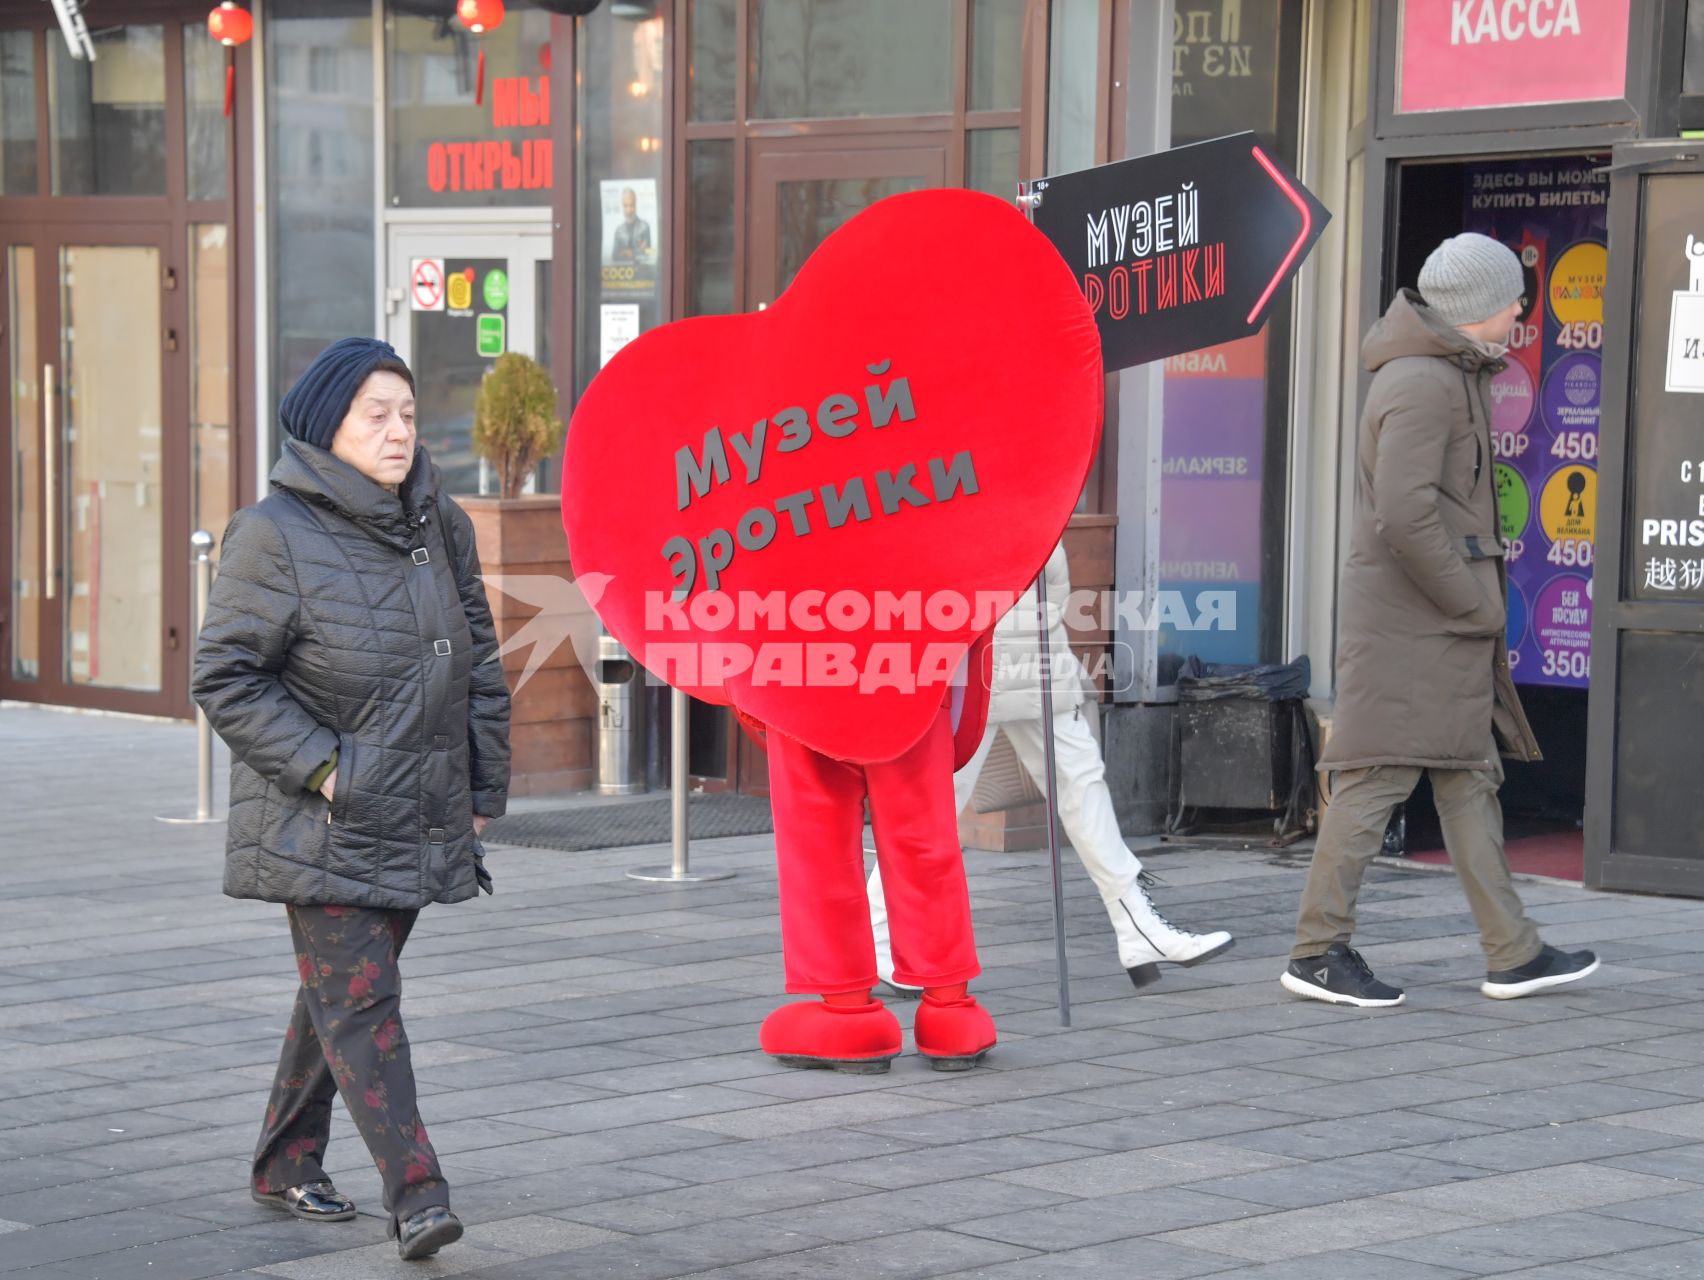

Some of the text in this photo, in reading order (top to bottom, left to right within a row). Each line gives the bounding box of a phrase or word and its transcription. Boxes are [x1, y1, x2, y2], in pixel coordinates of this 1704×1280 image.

[1450, 0, 1582, 46] КАССА
[492, 75, 550, 128] МЫ
[427, 139, 553, 192] ОТКРЫЛ
[1472, 173, 1525, 190] ЗДЕСЬ
[1528, 171, 1554, 187] ВЫ
[1036, 181, 1050, 191] 18+
[1471, 189, 1606, 210] КУПИТЬ БИЛЕТЫ
[1086, 181, 1199, 268] МУЗЕЙ
[673, 358, 917, 512] Музей
[1550, 431, 1599, 461] 450
[659, 449, 981, 603] Эротики
[1642, 518, 1704, 548] PRIS
[1546, 537, 1595, 568] 450
